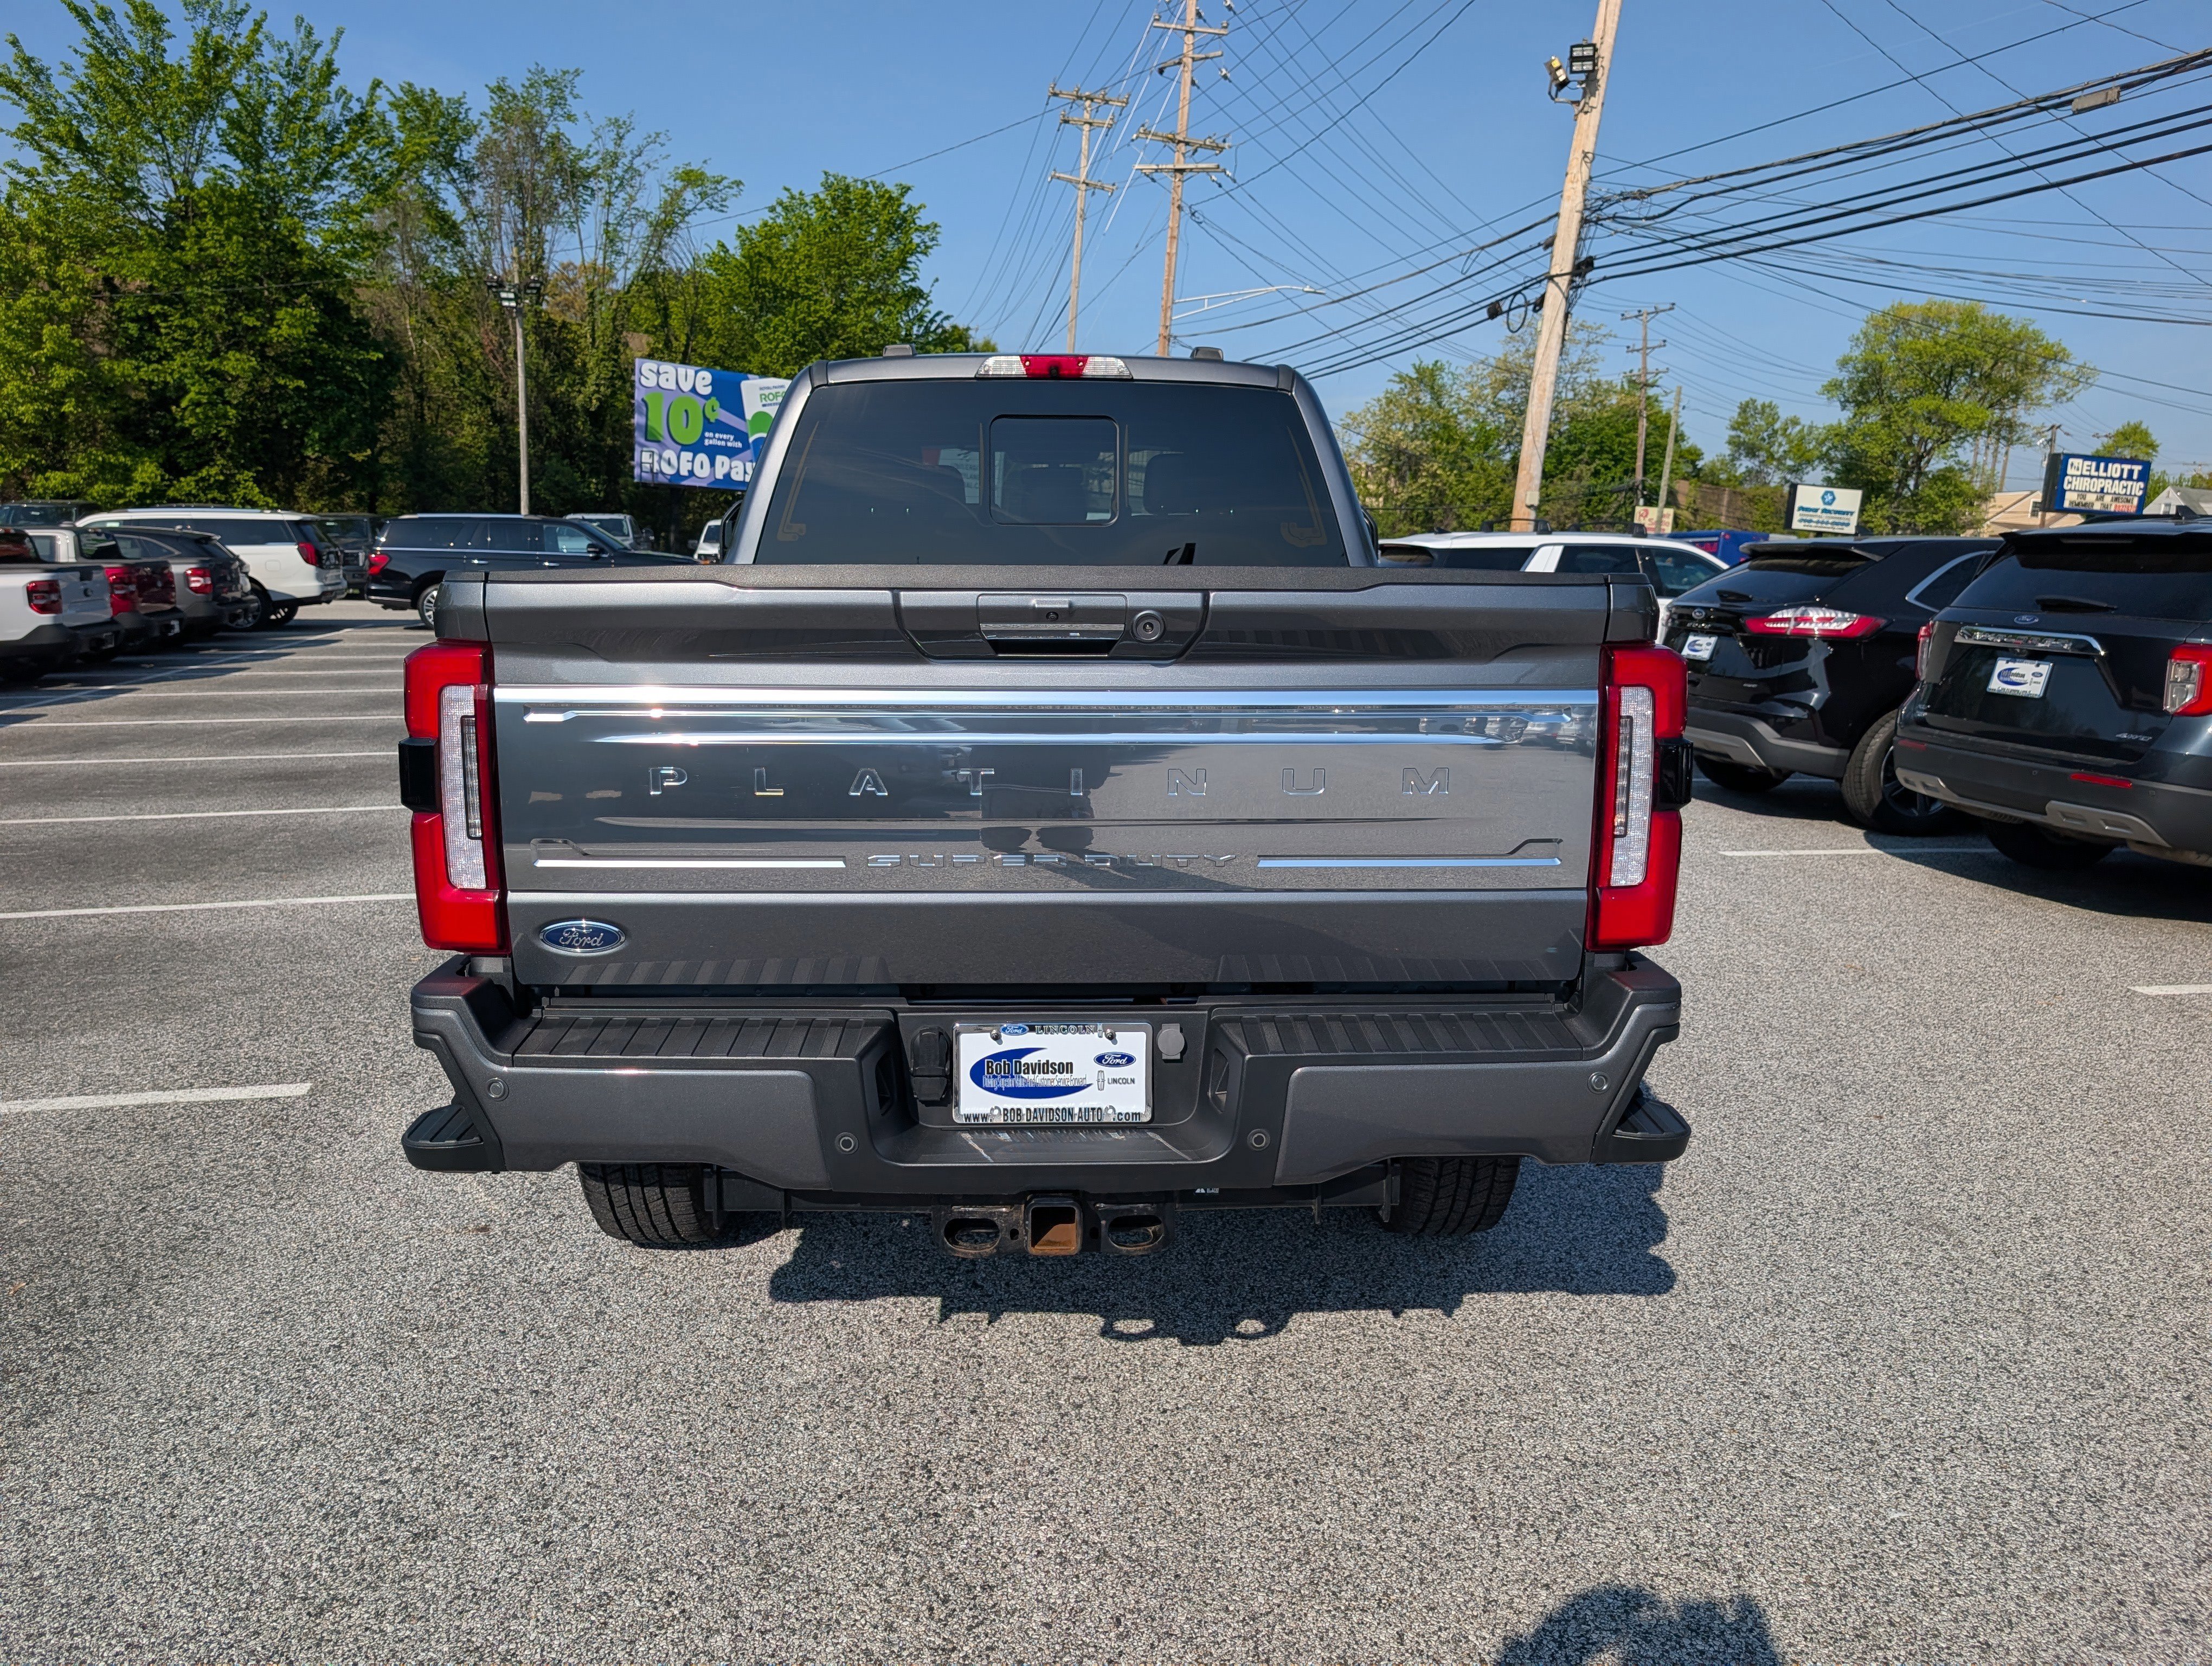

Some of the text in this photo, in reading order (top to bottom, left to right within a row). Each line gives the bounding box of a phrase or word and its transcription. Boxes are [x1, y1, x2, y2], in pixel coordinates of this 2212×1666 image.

[640, 363, 712, 395] save
[715, 432, 734, 441] every
[641, 448, 710, 478] ROFO
[2082, 460, 2143, 480] ELLIOTT
[2063, 475, 2145, 497] CHIROPRACTIC
[2068, 500, 2094, 508] REMEMBER
[648, 767, 1449, 796] PLATINUM
[867, 854, 1236, 868] SUPER DUTY
[559, 928, 605, 947] Ford
[1005, 1025, 1095, 1035] Ford LINCOLN
[986, 1059, 1073, 1075] Bob Davidson
[1102, 1054, 1128, 1065] Ford
[1036, 1075, 1055, 1087] Customer
[1055, 1074, 1070, 1087] Service
[1070, 1074, 1087, 1087] Forward
[1003, 1107, 1022, 1123] BOB
[1026, 1107, 1074, 1123] DAVIDSON
[1077, 1107, 1103, 1122] AUTO
[1113, 1112, 1141, 1122] .com
